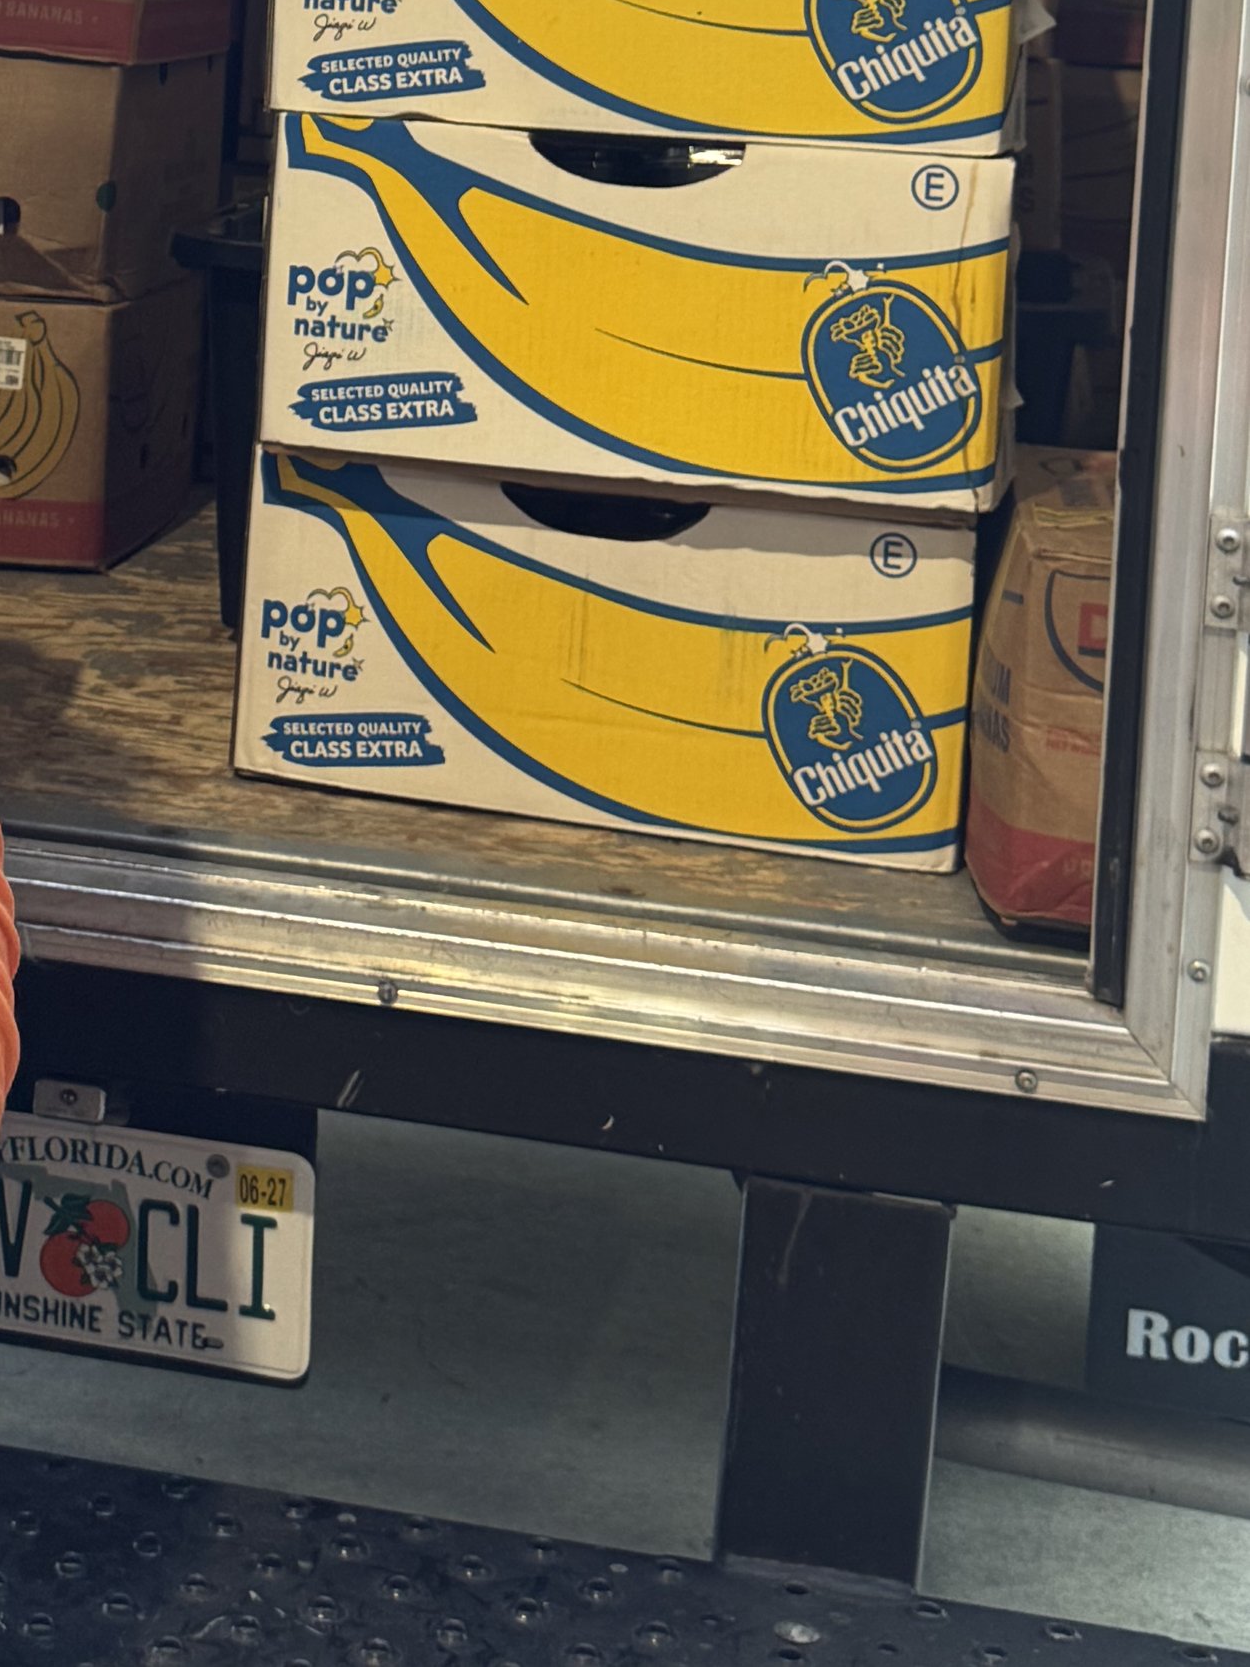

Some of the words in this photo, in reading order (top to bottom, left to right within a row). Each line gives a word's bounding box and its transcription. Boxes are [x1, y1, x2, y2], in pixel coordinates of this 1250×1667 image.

[4, 0, 84, 27] BANANAS
[321, 54, 393, 74] SELECTED
[397, 48, 462, 68] QUALITY
[837, 15, 978, 101] Chiquita
[329, 74, 391, 95] CLASS
[396, 67, 463, 88] EXTRA
[287, 265, 375, 311] pop
[306, 296, 329, 316] by
[294, 315, 389, 343] nature
[311, 384, 384, 402] SELECTED
[388, 380, 453, 397] QUALITY
[834, 363, 977, 448] Chiquita
[319, 403, 382, 424] CLASS
[386, 399, 455, 421] EXTRA
[261, 599, 345, 648] pop
[279, 630, 301, 652] by
[267, 651, 359, 682] nature
[283, 722, 354, 736] SELECTED
[358, 721, 422, 738] QUALITY
[290, 740, 352, 759] CLASS
[356, 740, 423, 759] EXTRA
[792, 727, 933, 807] Chiquita
[239, 1177, 288, 1207] 06-27
[138, 1199, 278, 1321] CLI
[118, 1310, 208, 1350] STATE
[1126, 1308, 1249, 1369] Roc
